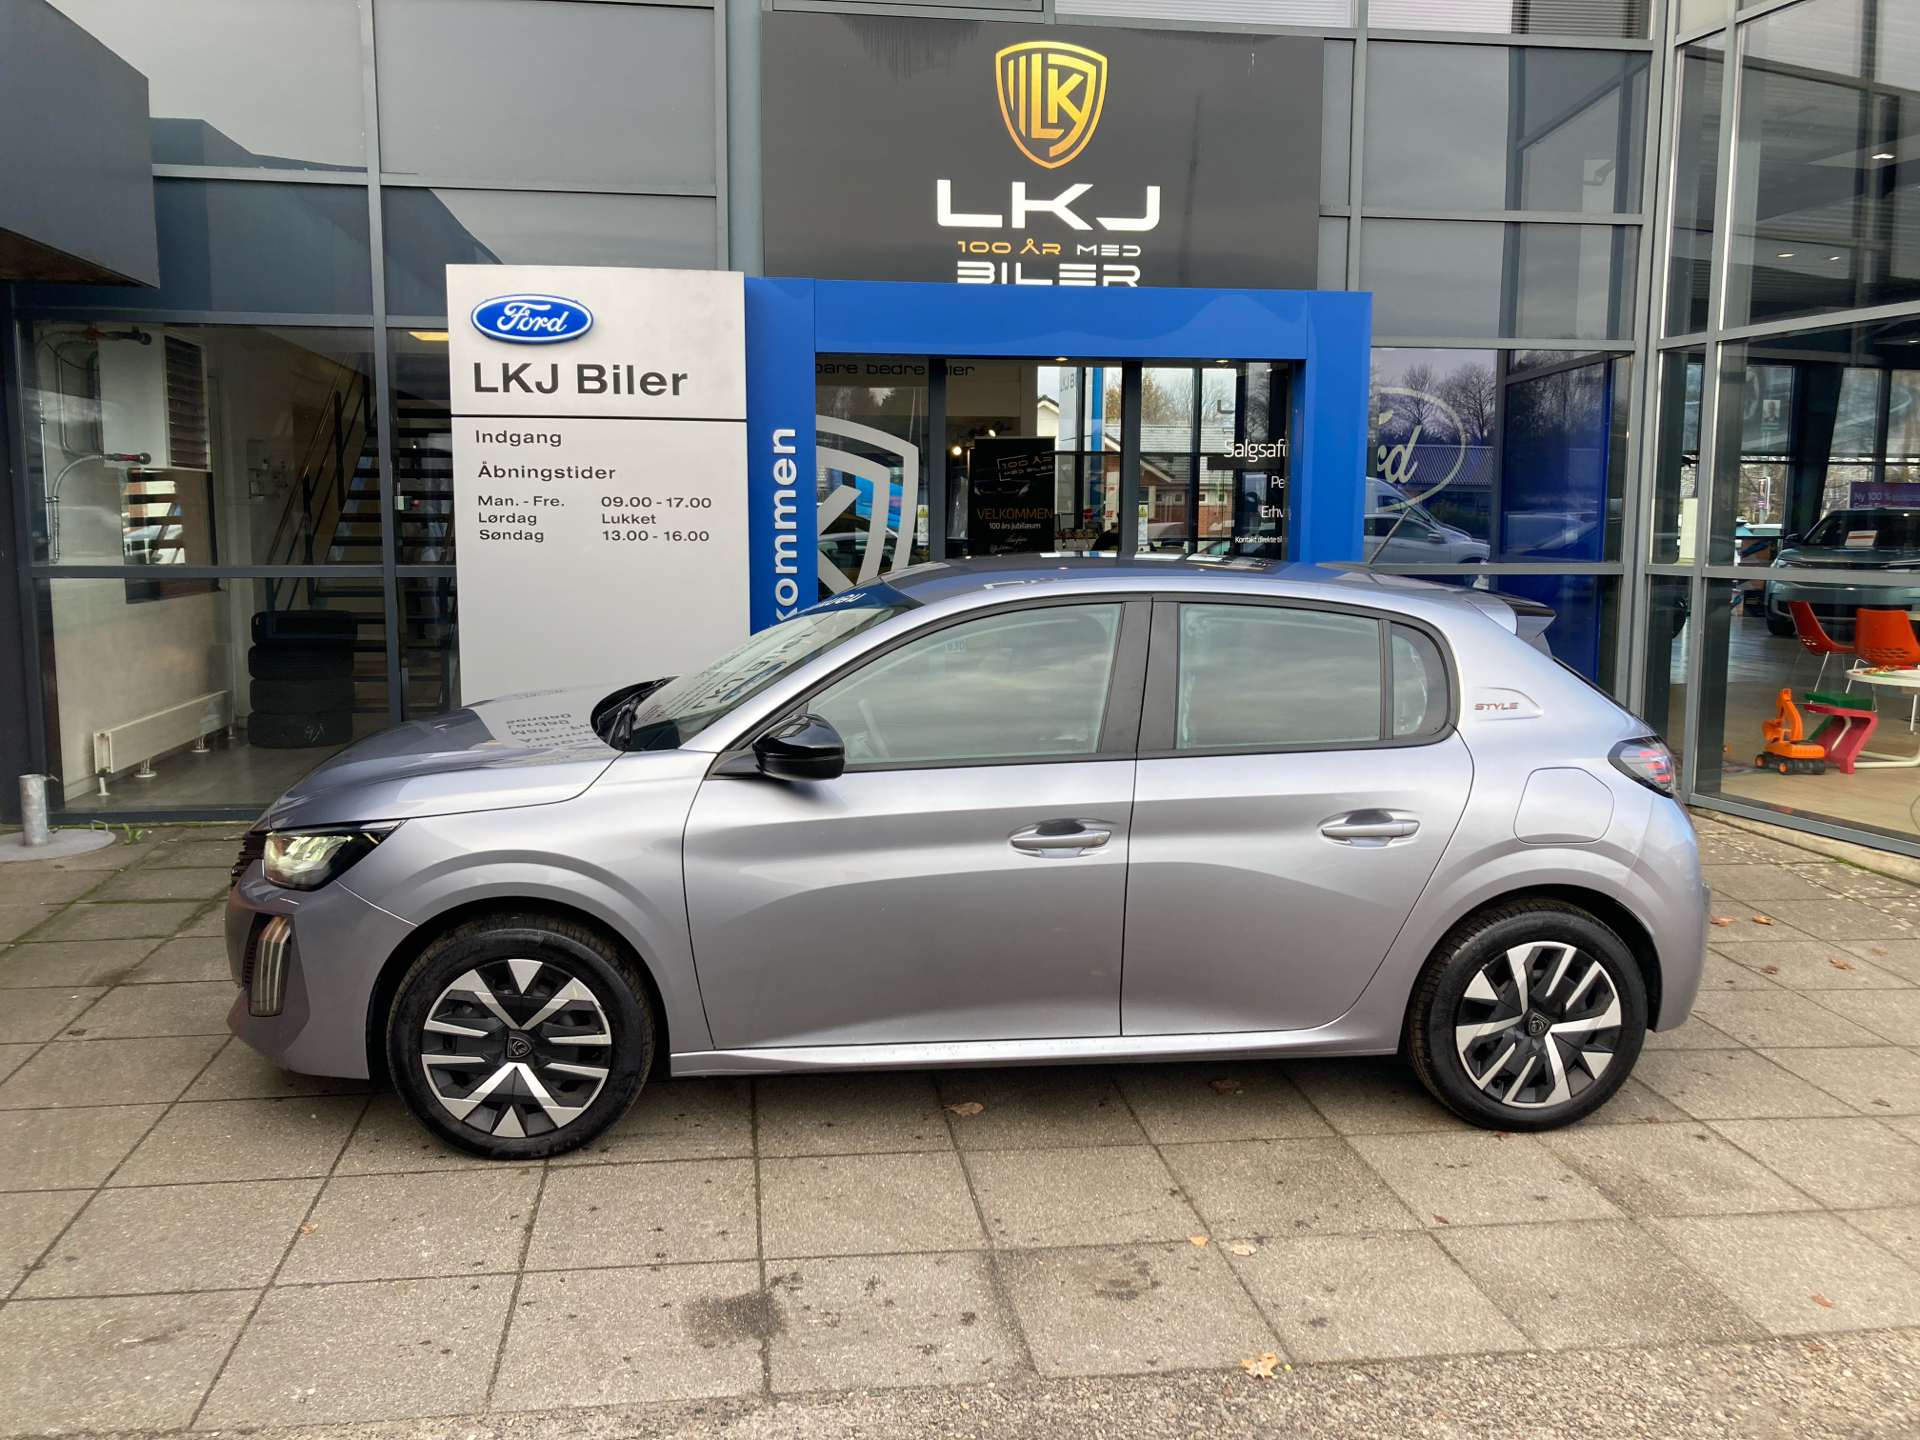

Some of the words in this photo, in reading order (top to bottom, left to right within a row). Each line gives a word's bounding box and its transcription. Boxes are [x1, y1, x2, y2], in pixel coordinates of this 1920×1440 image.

[937, 179, 1160, 231] LKJ
[957, 240, 1012, 254] 100
[1020, 238, 1062, 255] ÅR
[1076, 244, 1141, 257] MED
[957, 261, 1141, 287] BILER
[497, 302, 569, 332] Ford
[866, 363, 926, 375] bedre
[473, 362, 559, 394] LKJ
[576, 364, 688, 396] Biler
[475, 430, 562, 447] Indgang
[477, 461, 616, 482] Åbningstider
[477, 496, 519, 507] Man.
[533, 496, 565, 507] Fre.
[601, 497, 652, 508] 09.00
[666, 497, 712, 509] 17.00
[478, 512, 537, 526] Lørdag
[602, 513, 656, 525] Lukket
[977, 508, 1053, 520] VELKOMMEN
[479, 529, 544, 543] Søndag
[602, 530, 649, 542] 13.00
[663, 531, 710, 542] 16.00
[1474, 702, 1519, 711] STYLE
